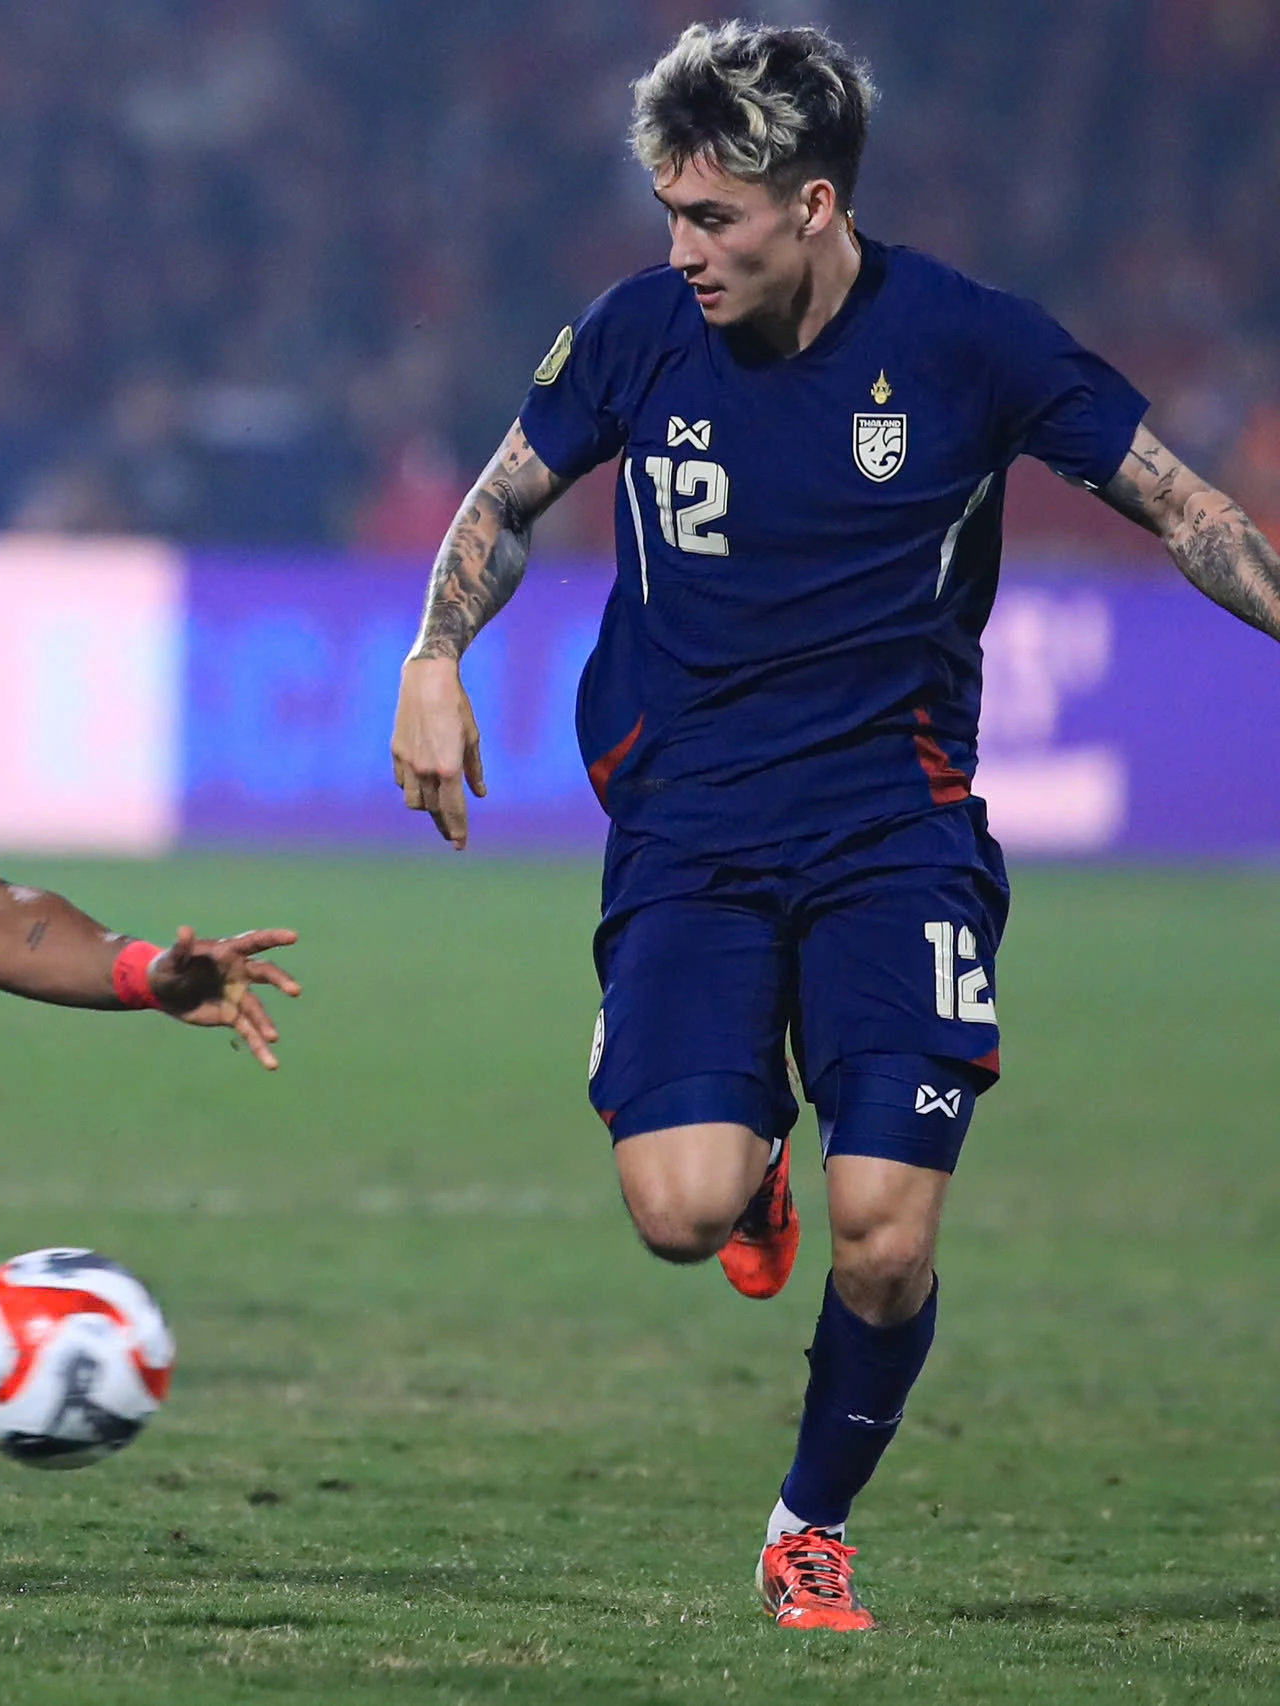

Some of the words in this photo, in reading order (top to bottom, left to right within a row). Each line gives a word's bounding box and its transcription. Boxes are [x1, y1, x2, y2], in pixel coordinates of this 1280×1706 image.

[858, 419, 901, 428] THAILAND
[645, 456, 730, 556] 12
[924, 921, 998, 1025] 12
